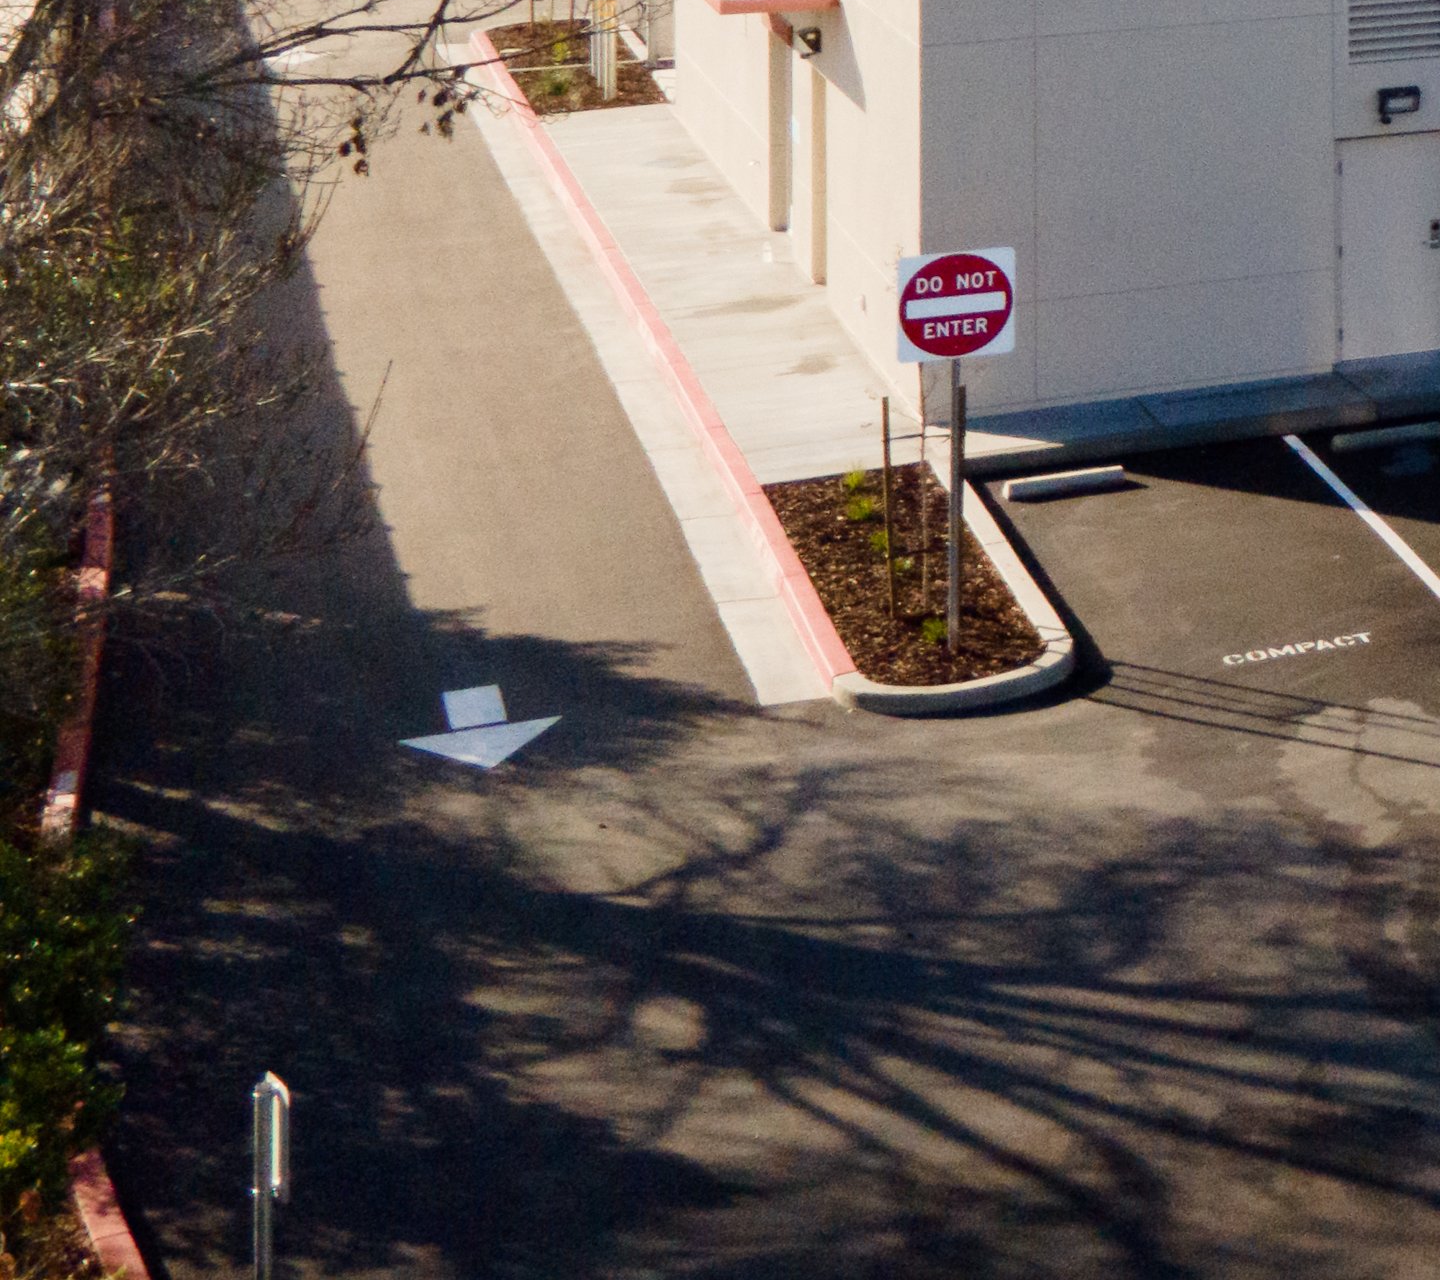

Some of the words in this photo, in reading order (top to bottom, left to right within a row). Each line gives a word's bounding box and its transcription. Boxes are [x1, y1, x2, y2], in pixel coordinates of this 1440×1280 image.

[915, 275, 943, 294] DO
[955, 270, 997, 290] NOT
[923, 317, 988, 340] ENTER
[1222, 631, 1371, 665] COMPACT
